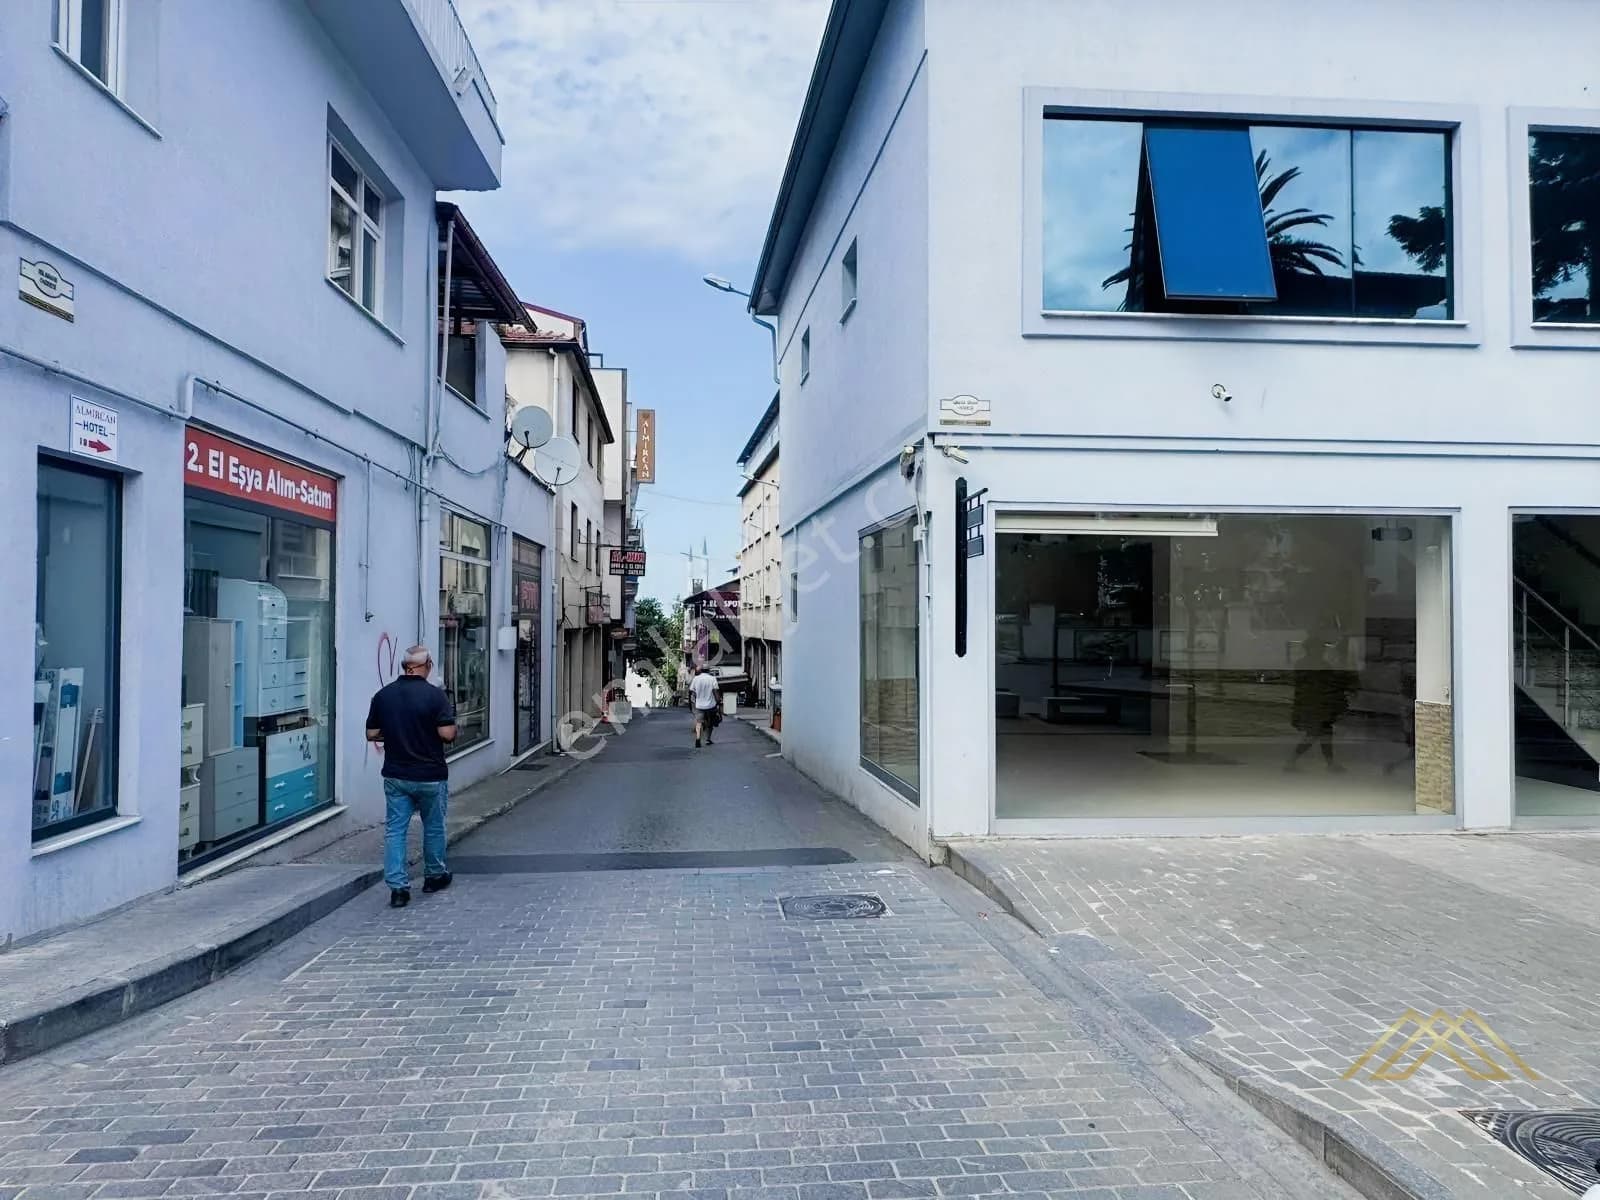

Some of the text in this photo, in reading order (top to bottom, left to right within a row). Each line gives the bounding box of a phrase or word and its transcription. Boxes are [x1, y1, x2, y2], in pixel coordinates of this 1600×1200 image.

[83, 420, 108, 437] HOTEL
[187, 442, 332, 510] 2. El Eşya Alım-Satım
